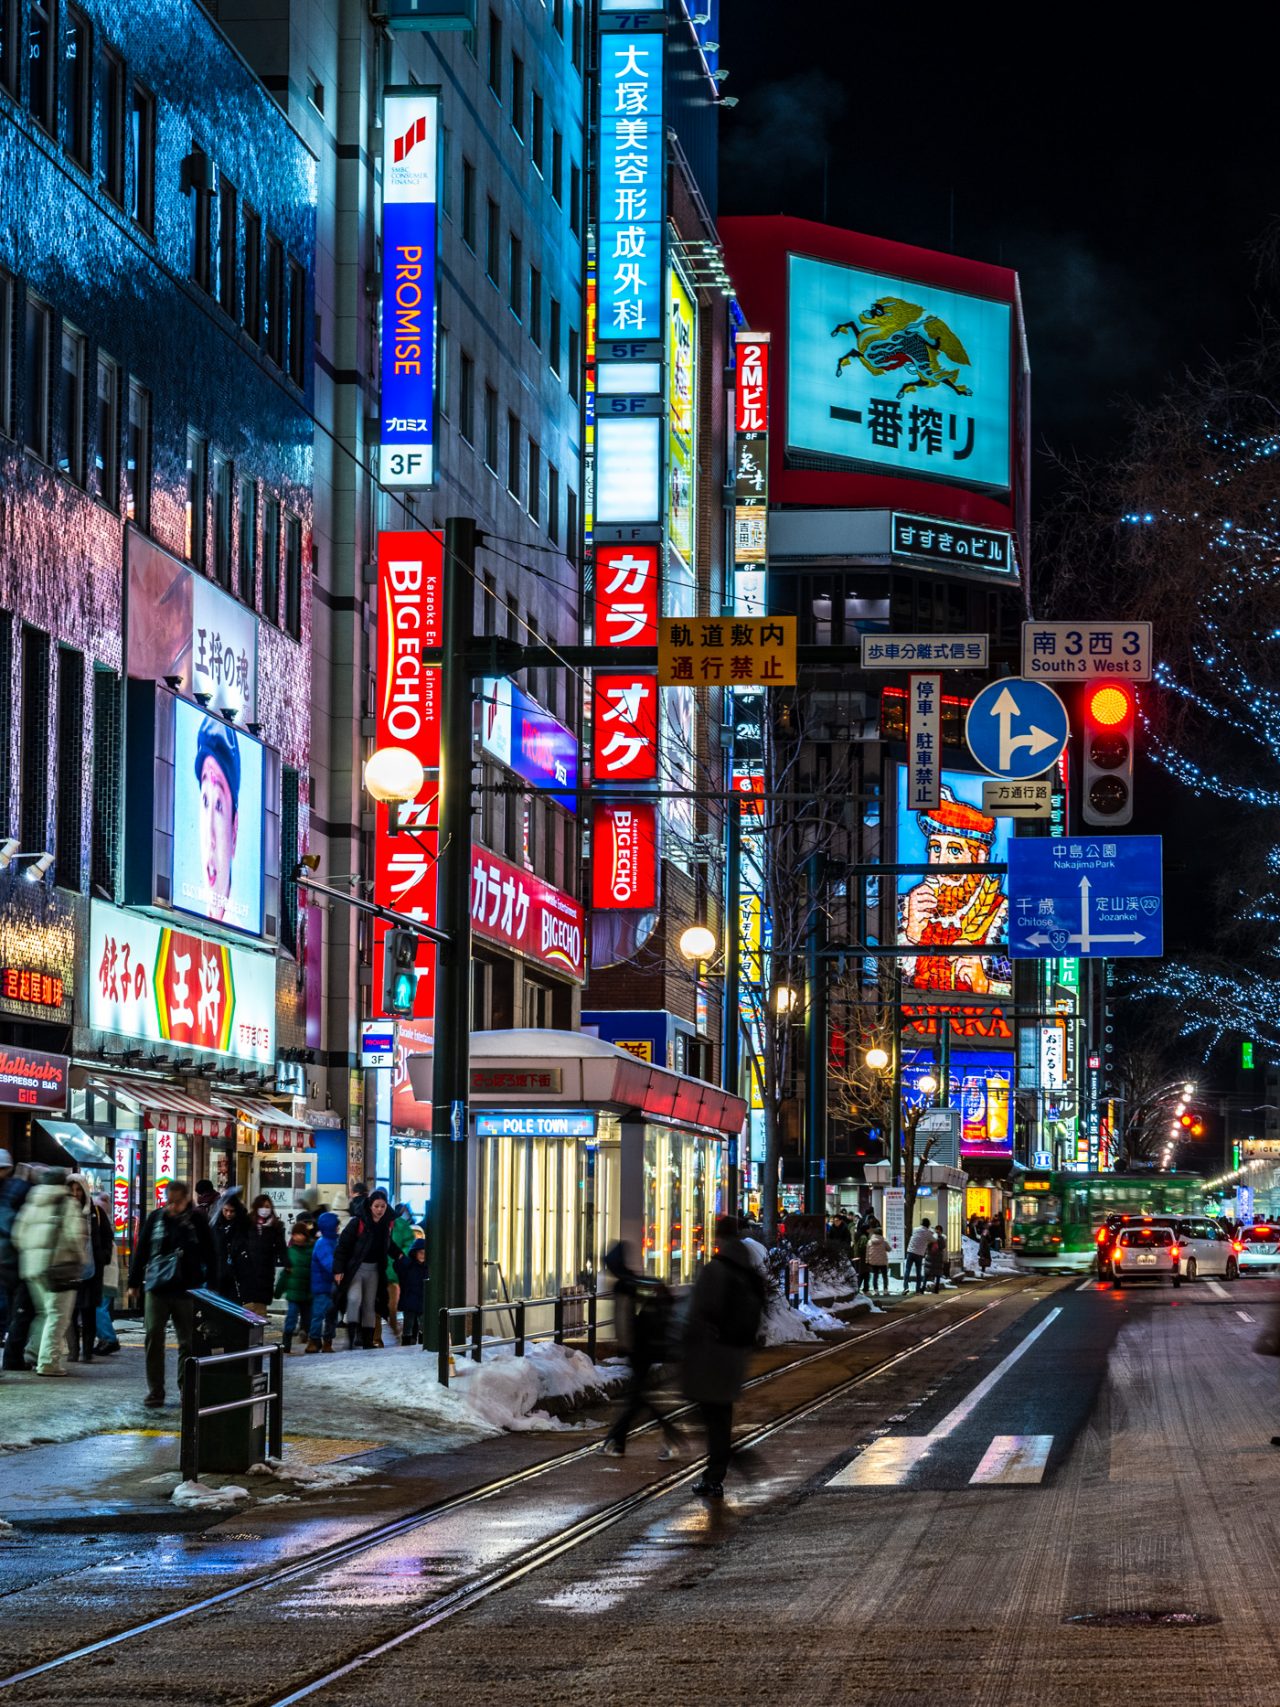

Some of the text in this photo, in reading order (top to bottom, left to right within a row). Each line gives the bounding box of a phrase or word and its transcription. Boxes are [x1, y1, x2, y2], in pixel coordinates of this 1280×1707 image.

[615, 16, 650, 29] 7F
[612, 44, 649, 331] 大塚美容形成外科
[395, 245, 423, 375] PROMISE
[611, 344, 647, 358] 5F
[739, 345, 764, 430] 2Mビル
[611, 399, 645, 412] 5F
[385, 417, 428, 433] プロミス
[829, 397, 975, 461] 一番搾り
[390, 453, 422, 475] 3F
[899, 526, 1003, 561] すすきのビル
[426, 576, 437, 625] Karaoke
[670, 623, 785, 648] 軌道敷内
[387, 561, 422, 740] BIG ECHO
[868, 643, 982, 661] 歩車分離式信号
[194, 628, 251, 702] 王将の魂
[600, 554, 650, 772] カラオケ
[670, 655, 785, 680] 通行禁止
[1031, 659, 1142, 673] South 3 West 3
[985, 786, 1048, 800] 一方通行路
[612, 810, 632, 902] BIG ECHO
[1053, 844, 1117, 859] 中島公園
[1053, 861, 1116, 870] Nakajima Park
[471, 858, 530, 940] カラオケ
[1016, 897, 1055, 916] 千歳
[1096, 896, 1139, 912] 定山渓
[1143, 901, 1158, 911] 230
[1017, 917, 1054, 927] Chitose
[1099, 912, 1138, 922] Jozankei
[542, 908, 581, 967] BIG ECHO
[1052, 931, 1066, 944] 36
[99, 933, 222, 1038] 餃子の 王将
[371, 1055, 385, 1065] 3F
[42, 1080, 58, 1091] BAR
[18, 1088, 37, 1104] GIG
[503, 1117, 568, 1134] POLE TOWN
[158, 1134, 172, 1174] 餃子の
